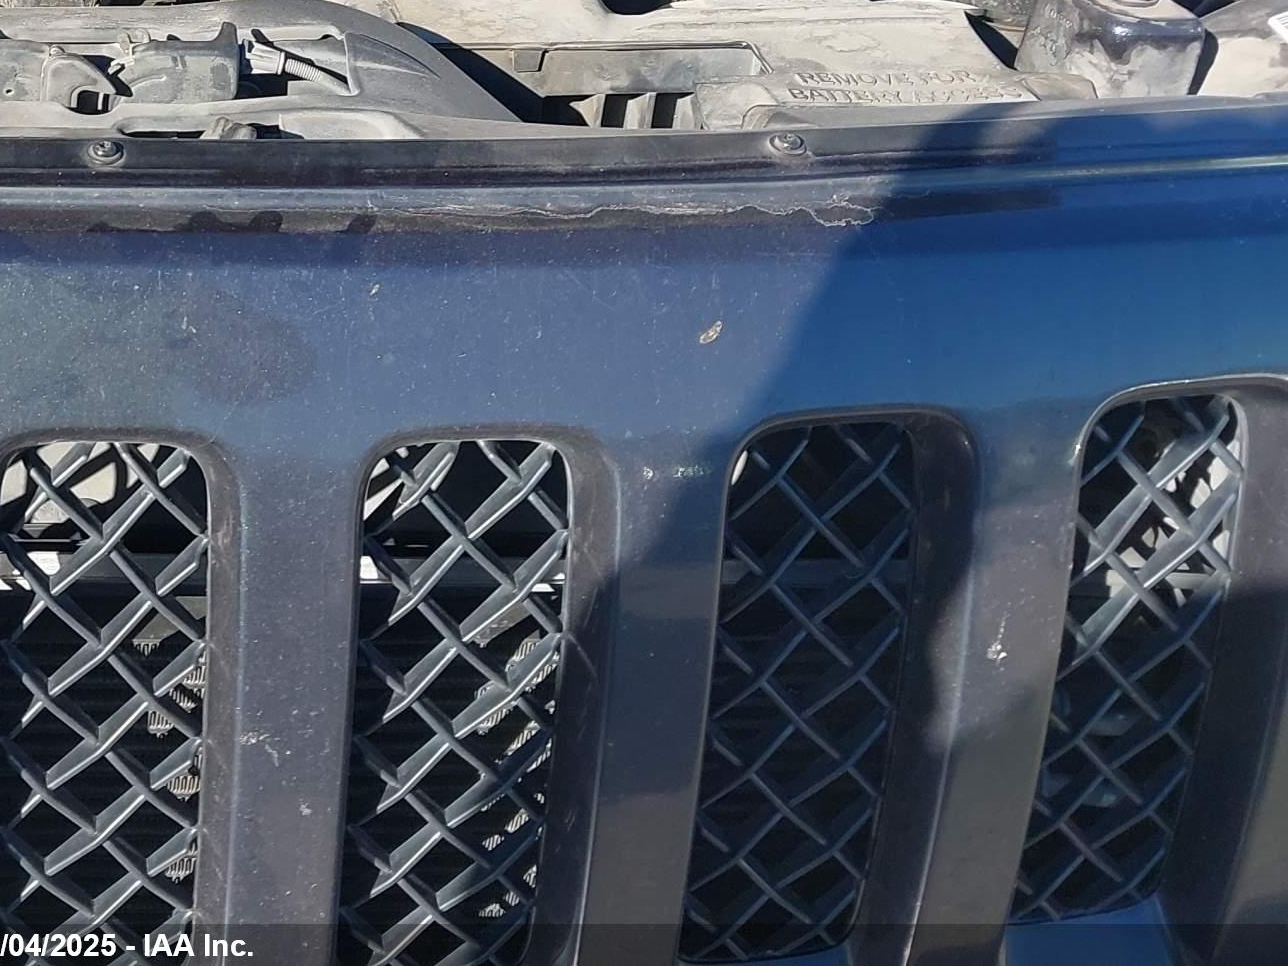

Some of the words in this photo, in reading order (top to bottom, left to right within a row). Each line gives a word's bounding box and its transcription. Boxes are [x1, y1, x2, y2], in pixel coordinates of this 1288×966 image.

[795, 72, 913, 86] REMOVE
[918, 70, 978, 84] FOR
[788, 88, 903, 103] BATTERY
